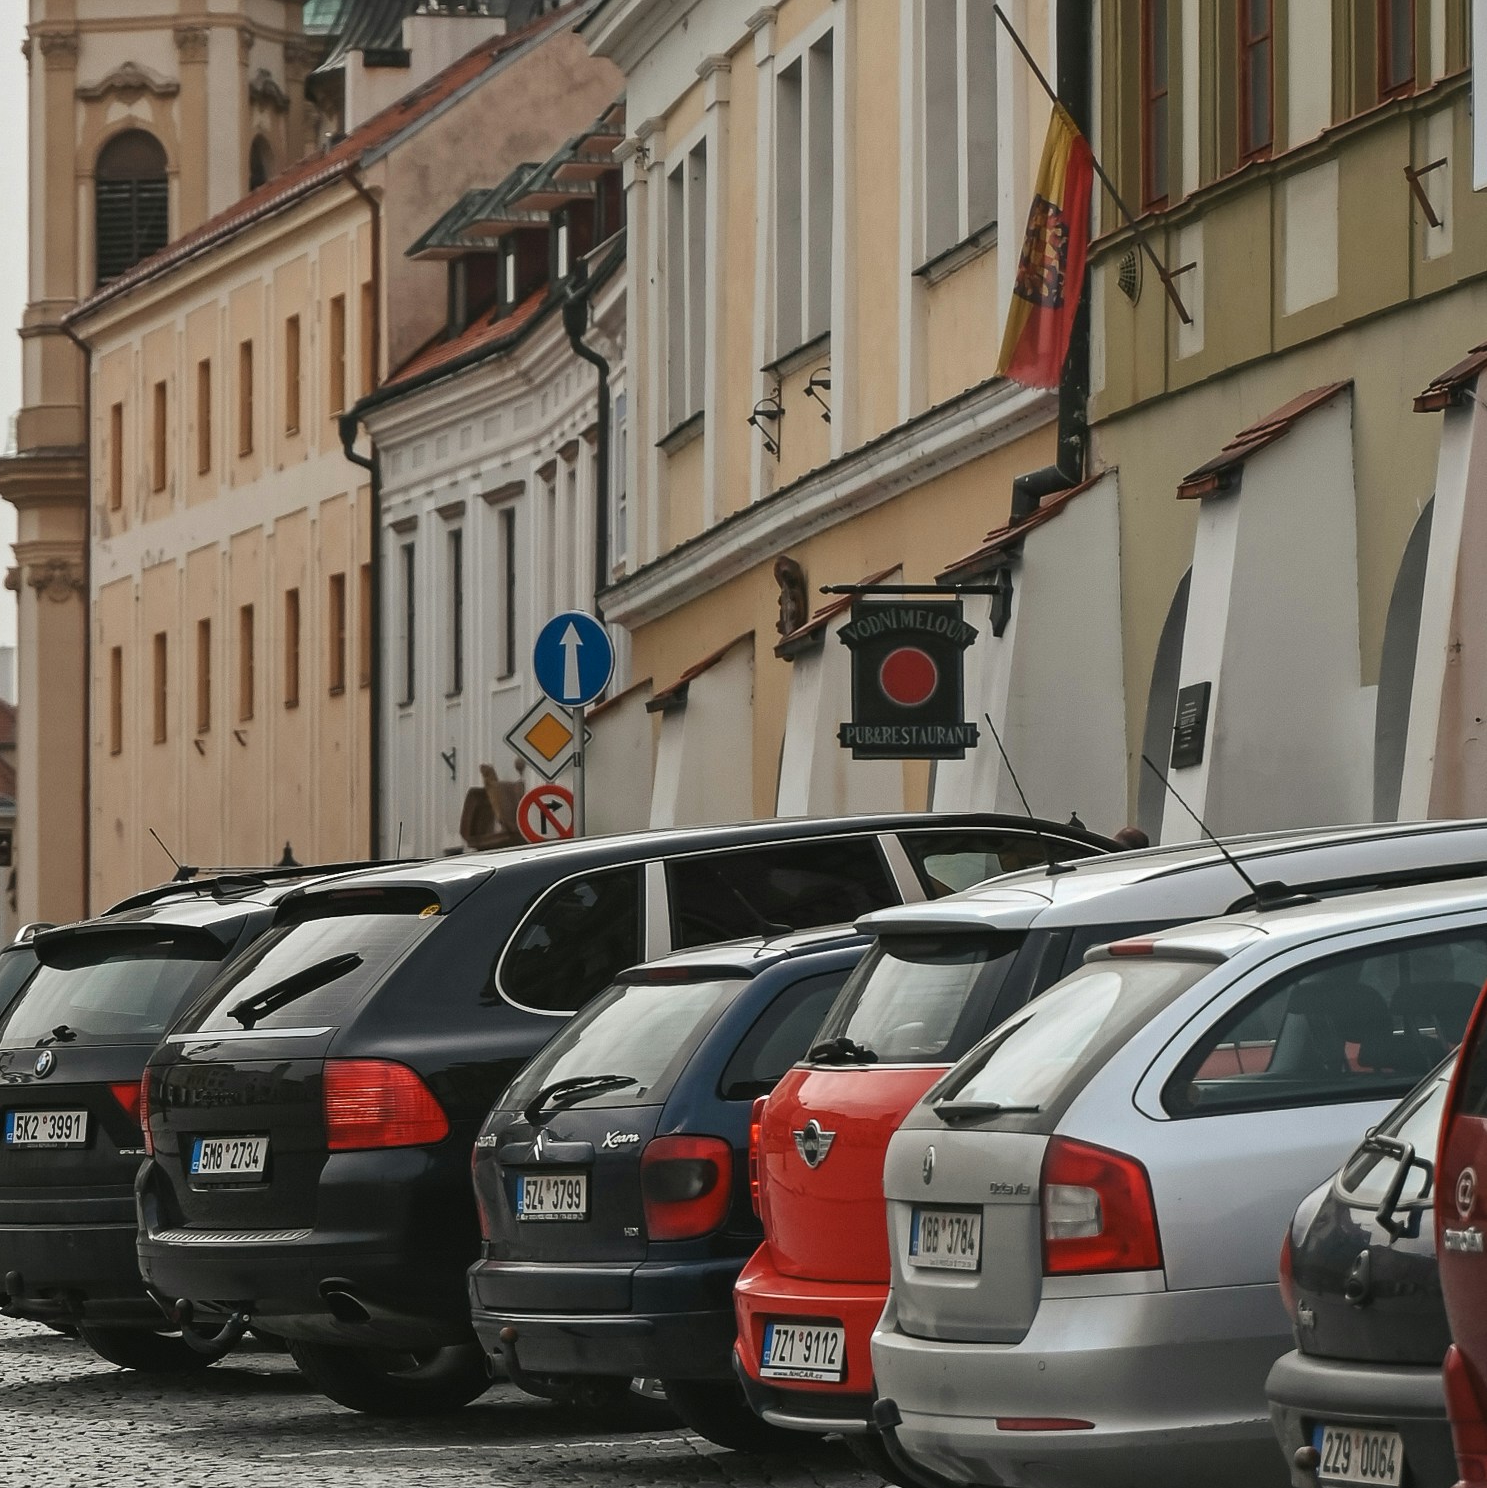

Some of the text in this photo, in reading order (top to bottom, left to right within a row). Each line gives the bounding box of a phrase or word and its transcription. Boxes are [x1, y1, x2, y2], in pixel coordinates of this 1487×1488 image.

[845, 607, 973, 643] VODNÍ MELOUN
[16, 1115, 39, 1141] 5K2
[48, 1114, 81, 1140] 3991
[202, 1143, 223, 1170] 5M8
[230, 1141, 260, 1169] 2734
[525, 1180, 544, 1210] 5Z4
[552, 1180, 581, 1210] 3799
[946, 1217, 975, 1255] 3784
[772, 1329, 795, 1362] 7Z1
[803, 1330, 838, 1364] 9112
[1323, 1432, 1396, 1480] 2Z9 0064
